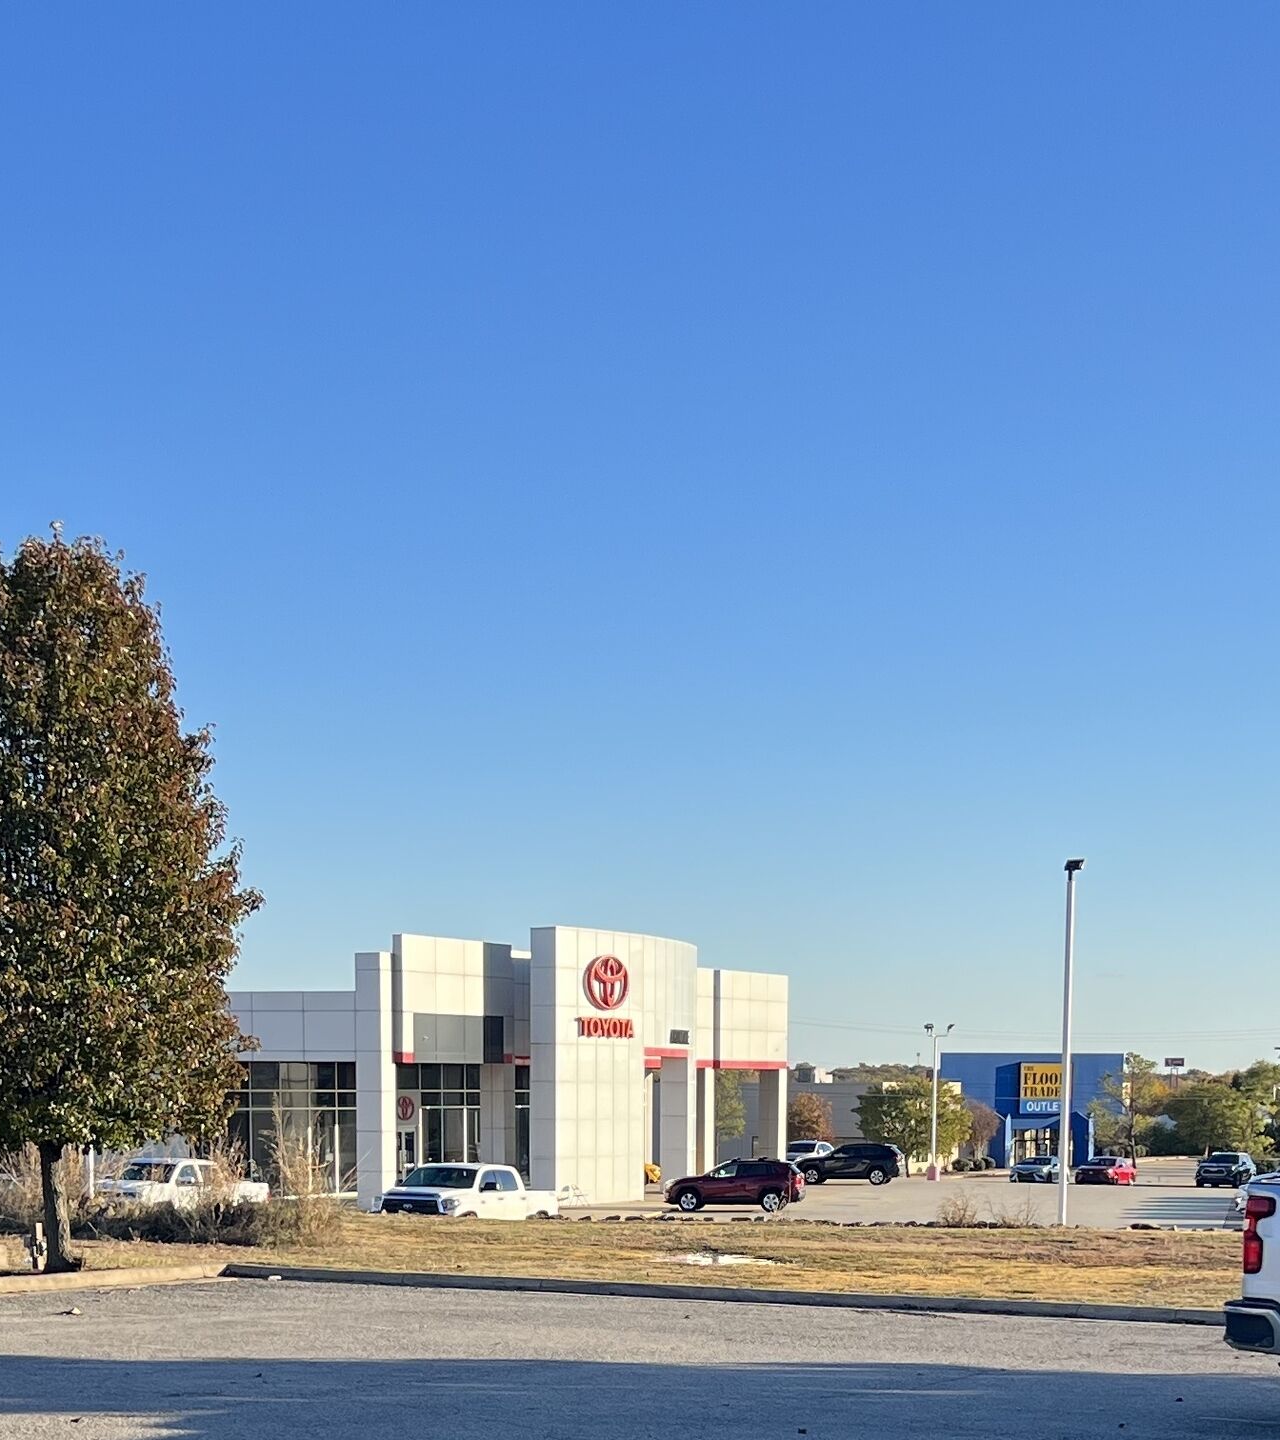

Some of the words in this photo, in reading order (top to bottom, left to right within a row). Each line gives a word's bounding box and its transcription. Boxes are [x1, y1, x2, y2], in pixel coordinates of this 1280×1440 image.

[576, 1016, 635, 1039] TOYOTA
[1022, 1086, 1062, 1098] TRADE
[1026, 1101, 1062, 1112] OUTLE
